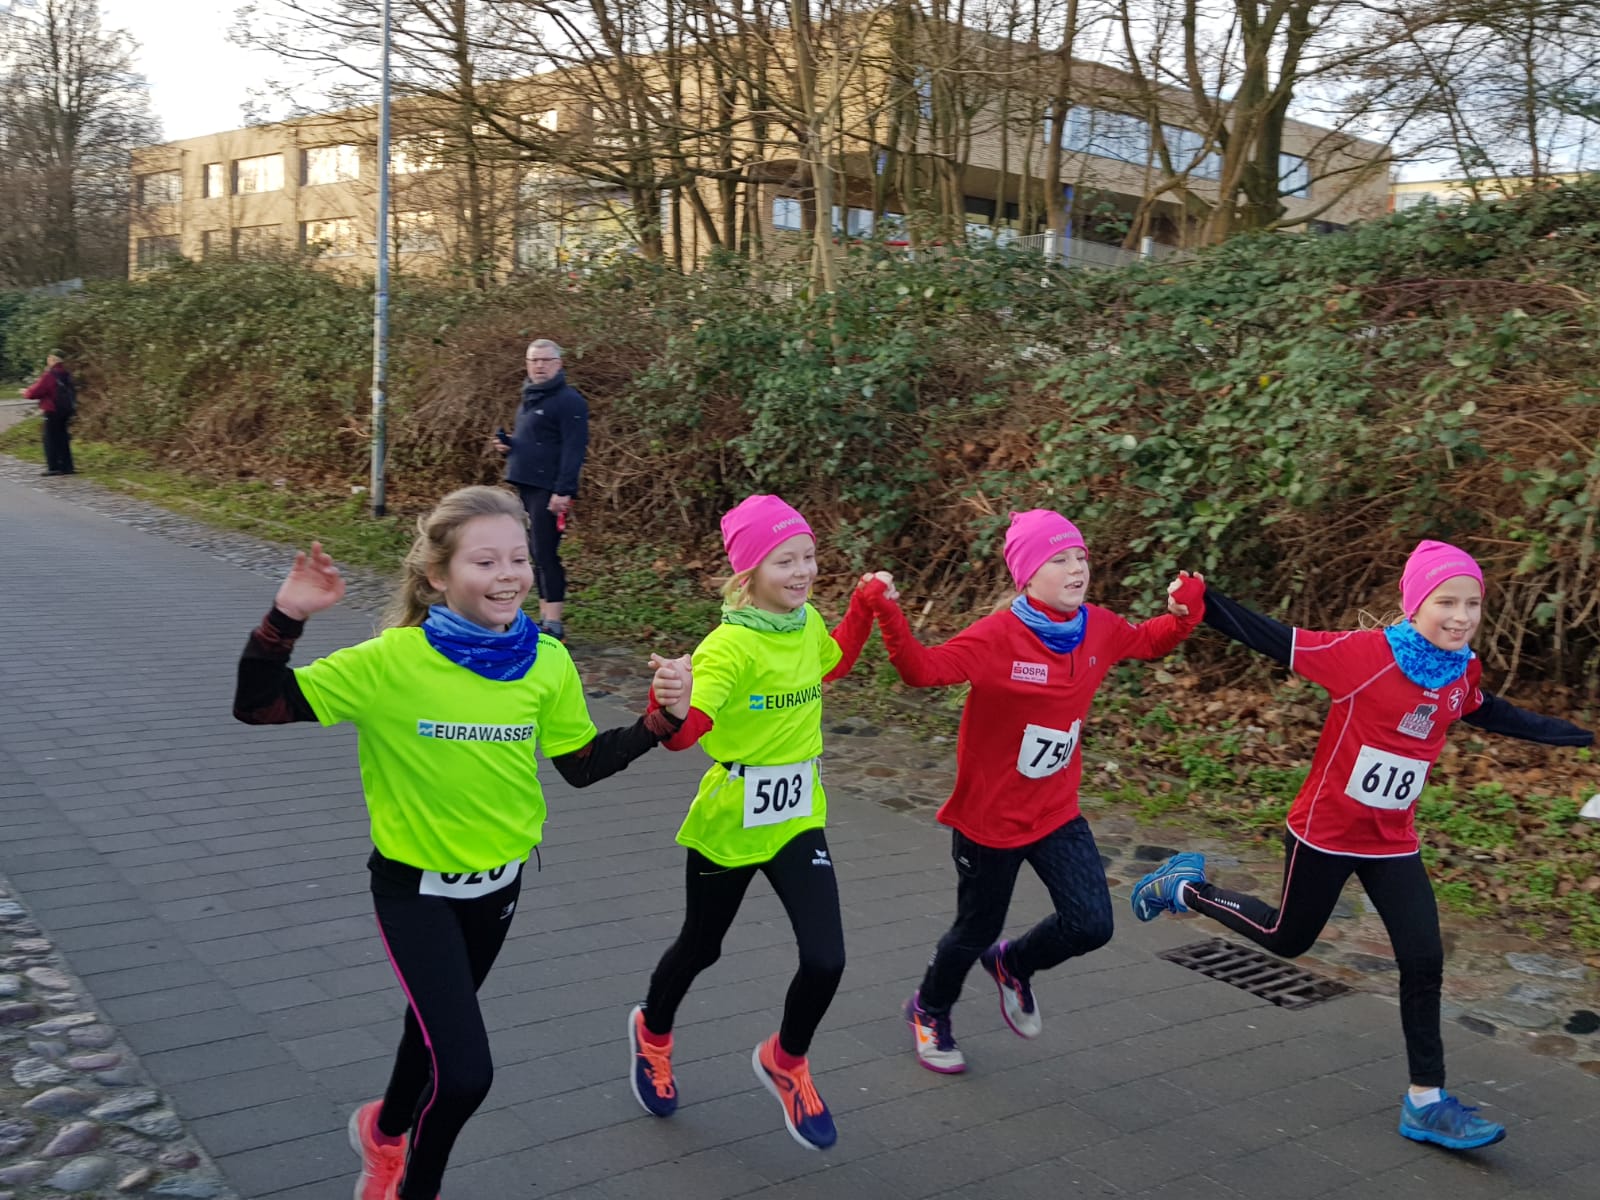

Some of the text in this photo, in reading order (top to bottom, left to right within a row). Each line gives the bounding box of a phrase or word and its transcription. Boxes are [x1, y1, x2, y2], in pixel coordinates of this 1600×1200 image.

[435, 725, 534, 742] EURAWASSER
[753, 774, 802, 814] 503
[1362, 762, 1415, 800] 618
